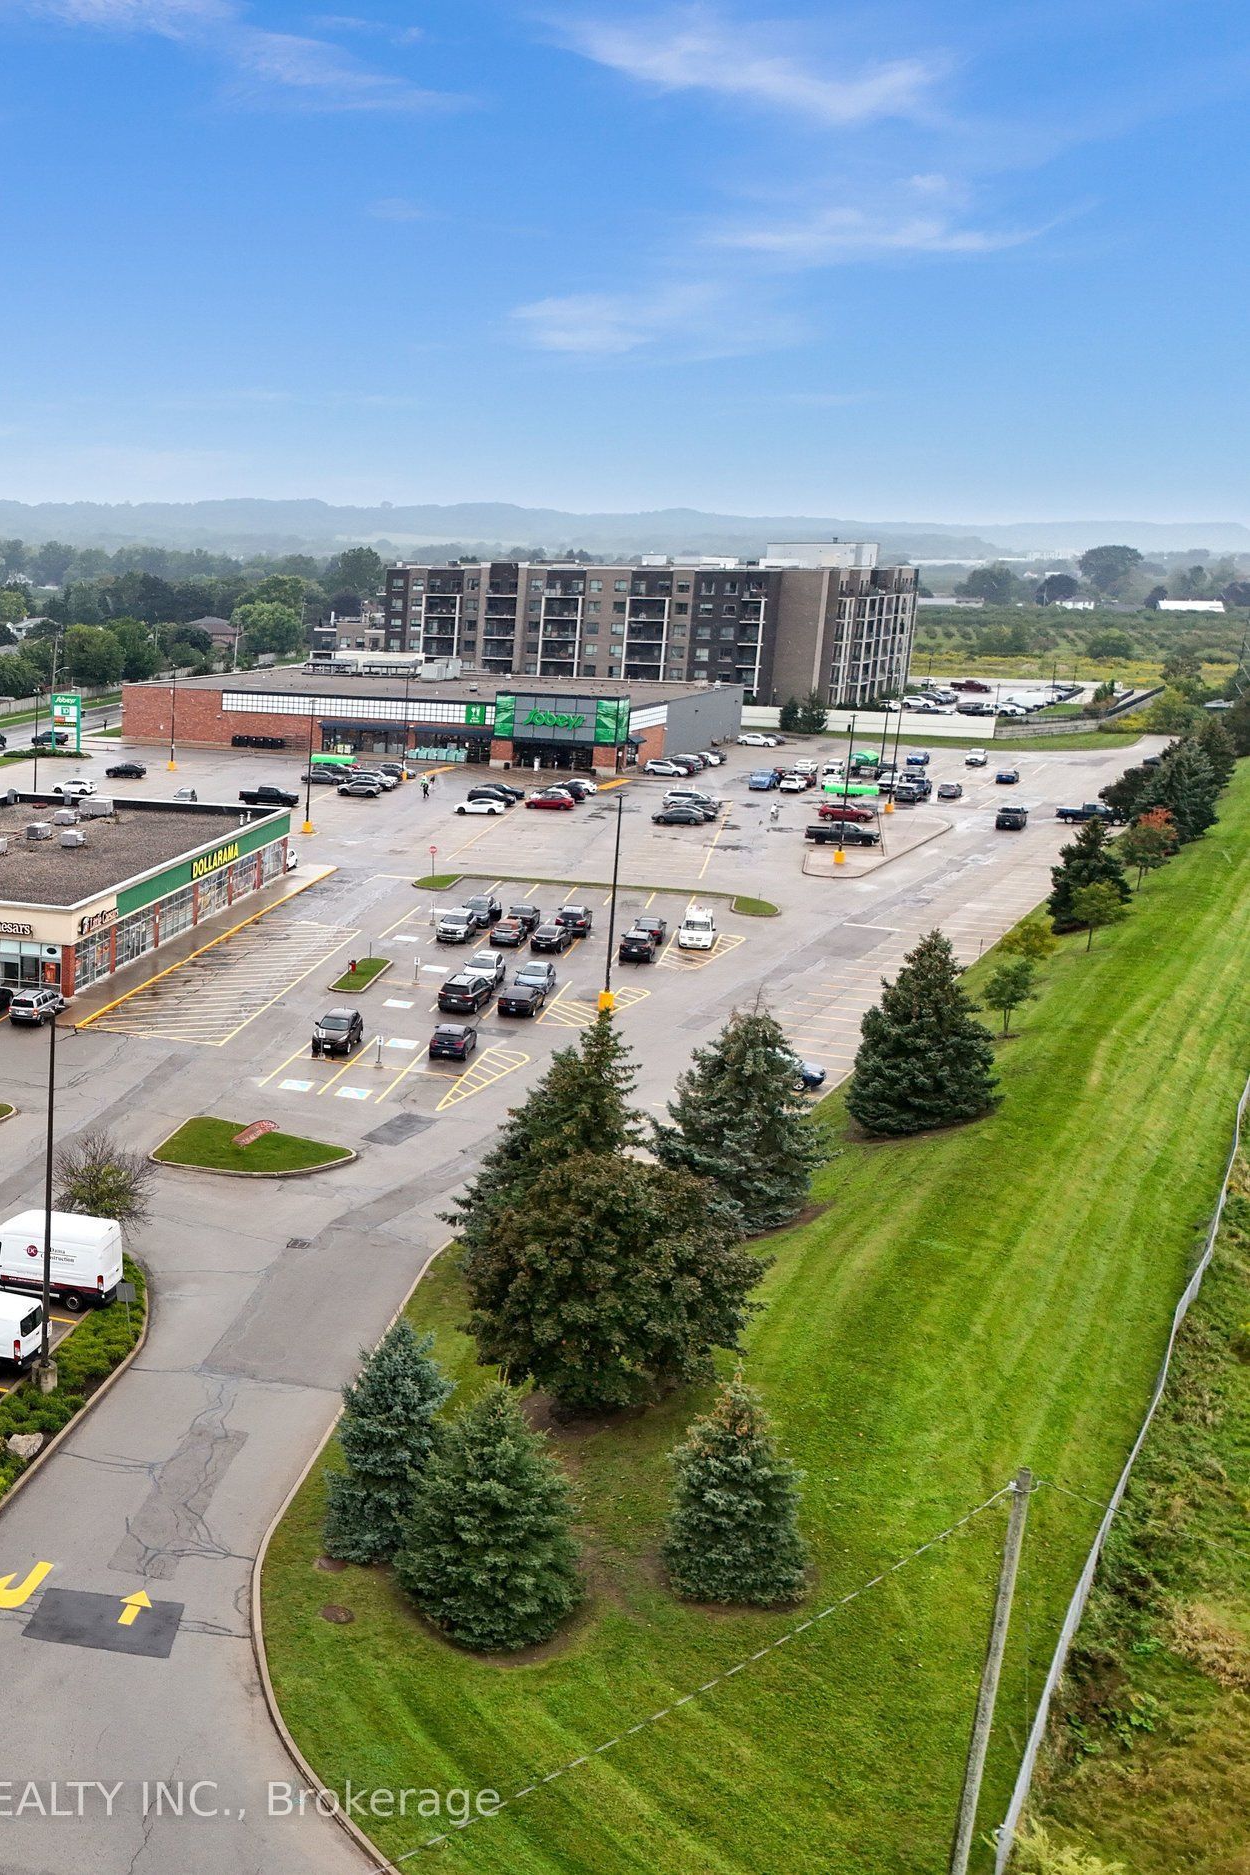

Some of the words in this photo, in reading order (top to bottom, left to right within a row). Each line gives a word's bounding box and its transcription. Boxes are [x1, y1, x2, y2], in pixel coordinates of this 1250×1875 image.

[523, 708, 586, 731] Sobeys
[192, 842, 239, 879] DOLLARAMA
[40, 1253, 75, 1263] Cstruction
